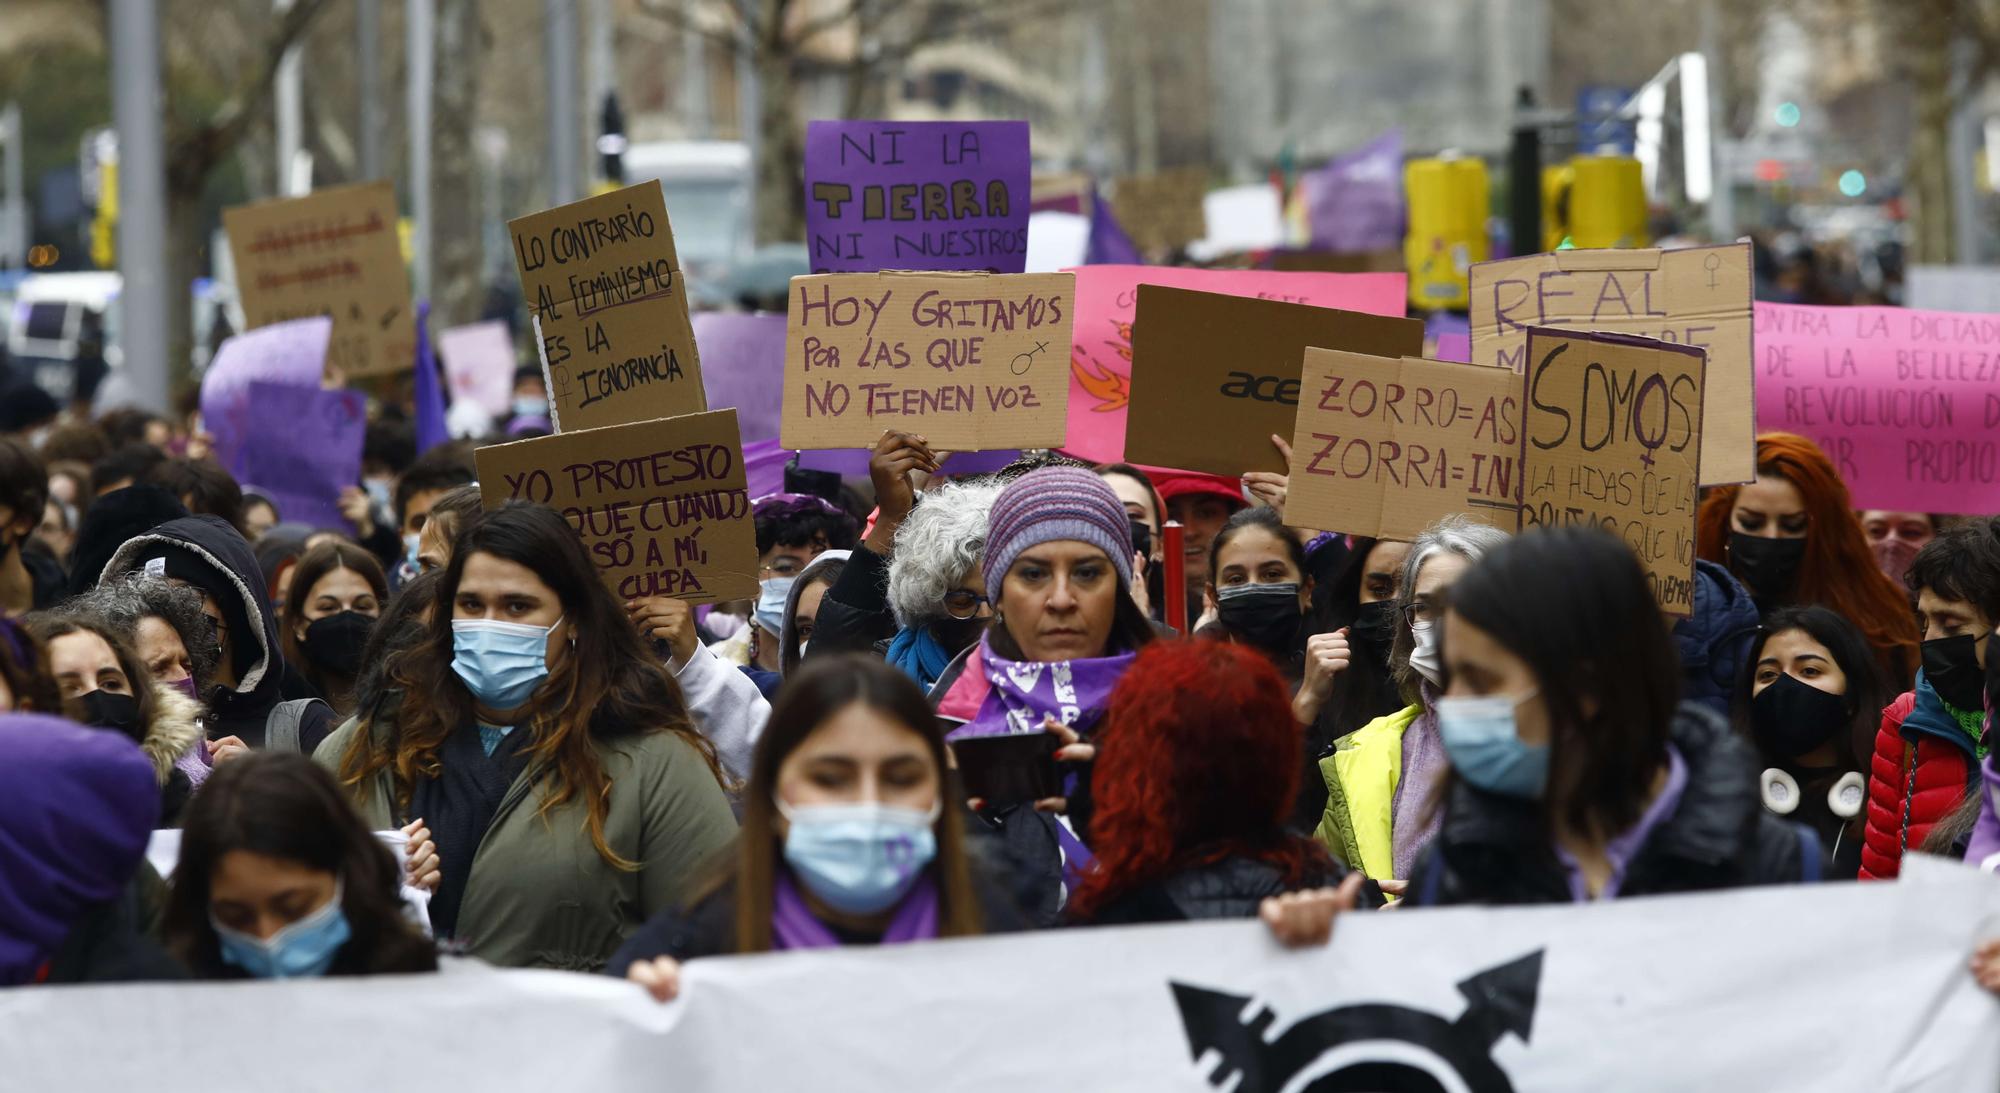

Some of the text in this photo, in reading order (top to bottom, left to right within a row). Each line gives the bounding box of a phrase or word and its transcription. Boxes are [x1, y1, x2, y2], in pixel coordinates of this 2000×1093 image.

[841, 131, 980, 165] NI LA
[813, 179, 1010, 222] TIERRA
[518, 231, 546, 272] LO
[816, 228, 1027, 260] NI NUESTROS
[536, 284, 562, 322] AL
[800, 284, 892, 336] HOY
[912, 290, 1061, 332] GRITAMOS
[1494, 271, 1667, 337] REAL
[545, 322, 611, 366] ES LA
[1754, 308, 2000, 345] ONTRA LA DICTAD
[857, 337, 911, 370] LAS
[926, 336, 984, 372] QUE
[1767, 344, 1793, 378] DE
[1824, 347, 1858, 379] LA
[805, 380, 1041, 418] NO TIENEN VOZ
[1220, 371, 1299, 405] ace
[1531, 342, 1696, 453] SOMOS
[1785, 385, 1953, 429] REVOLUCIÓN
[504, 444, 732, 503] YO PROTESTO
[639, 489, 749, 532] CUANDO
[645, 537, 664, 567] A
[618, 569, 703, 600] CULPA
